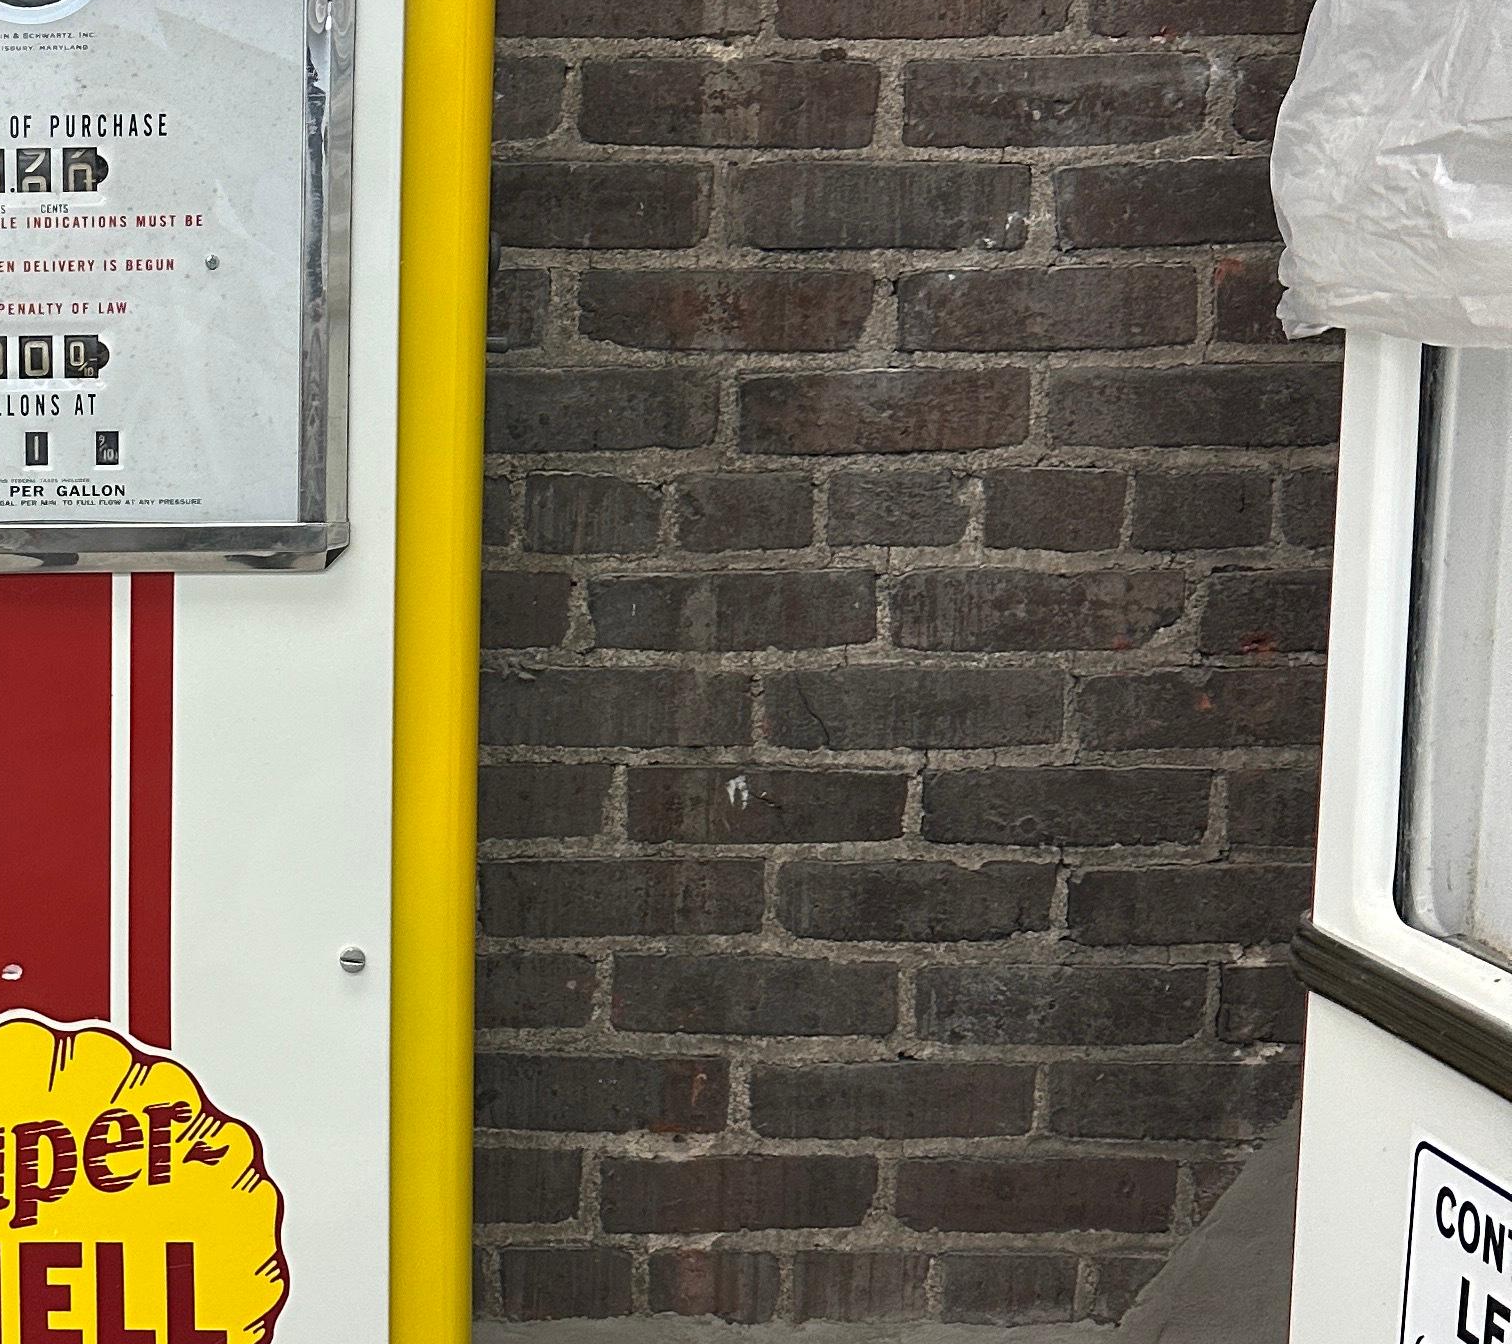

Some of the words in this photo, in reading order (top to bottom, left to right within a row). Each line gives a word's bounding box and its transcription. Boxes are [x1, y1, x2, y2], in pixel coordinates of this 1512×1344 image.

[9, 114, 32, 139] OF
[50, 113, 168, 138] PURCHASE
[41, 204, 69, 214] CENTS
[26, 215, 127, 229] INDICATIONS
[136, 214, 177, 228] MUST
[185, 214, 203, 227] BE
[23, 259, 95, 273] DELIVERY
[103, 259, 117, 272] IS
[125, 258, 174, 272] BEGUN
[71, 302, 89, 315] OF
[98, 301, 127, 315] LAW
[74, 393, 97, 416] AT
[9, 485, 45, 497] PER
[56, 484, 126, 497] GALLON
[124, 498, 135, 506] AT
[1436, 1186, 1512, 1273] CON
